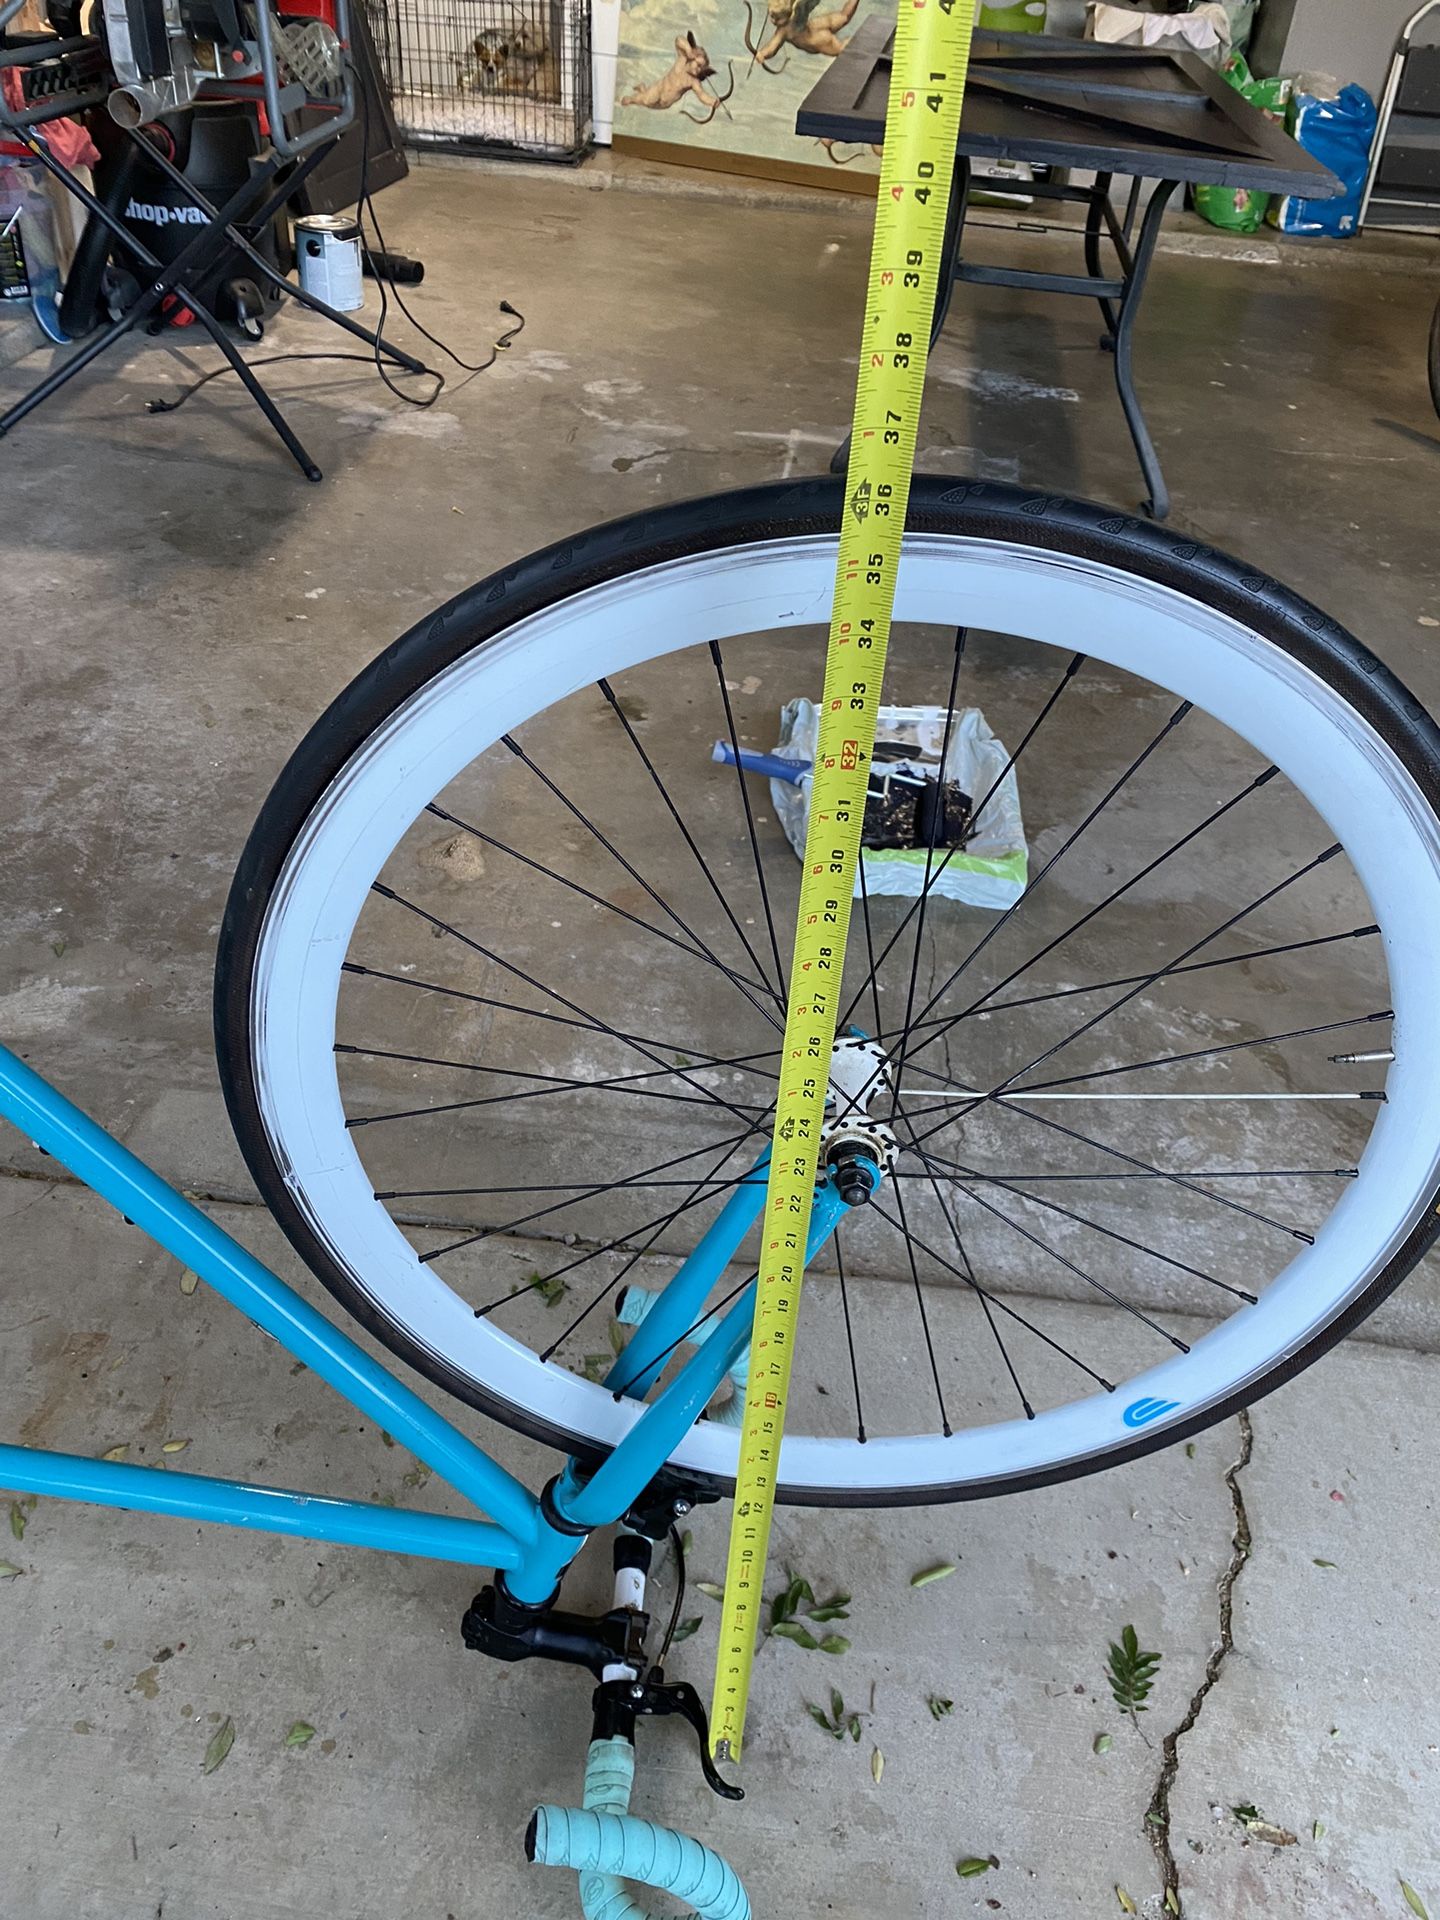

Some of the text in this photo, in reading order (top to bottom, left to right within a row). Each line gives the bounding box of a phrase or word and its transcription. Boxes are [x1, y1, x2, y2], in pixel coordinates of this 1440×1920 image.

[901, 92, 915, 107] 5
[927, 73, 946, 113] 41
[915, 162, 934, 205] 40
[891, 185, 904, 201] 4
[904, 250, 923, 288] 39
[881, 272, 894, 285] 3
[894, 333, 912, 368] 38
[872, 354, 884, 367] 2
[884, 411, 902, 444] 37
[856, 489, 869, 513] 3F
[875, 484, 892, 516] 36
[846, 560, 859, 580] 11
[867, 554, 883, 584] 35
[839, 623, 852, 645] 10
[858, 619, 875, 649] 34
[850, 682, 866, 710] 33
[832, 699, 842, 711] 9
[842, 742, 857, 767] 32
[825, 758, 835, 769] 8
[836, 800, 851, 821] 31
[819, 814, 829, 824] 7
[830, 850, 844, 873] 30
[813, 864, 823, 875] 6
[807, 914, 817, 924] 5
[824, 900, 838, 923] 29
[818, 947, 832, 969] 28
[803, 962, 812, 971] 4
[797, 1006, 807, 1015] 3
[813, 993, 826, 1014] 27
[792, 1049, 802, 1058] 2
[808, 1037, 821, 1057] 26
[803, 1078, 815, 1098] 25
[798, 1118, 811, 1138] 24
[779, 1162, 788, 1174] 11
[794, 1157, 806, 1176] 23
[774, 1197, 784, 1211] 10
[790, 1195, 801, 1213] 22
[785, 1233, 796, 1248] 21
[781, 1266, 792, 1283] 20
[778, 1299, 788, 1312] 19
[774, 1331, 784, 1344] 18
[756, 1371, 764, 1379] 5
[770, 1362, 780, 1375] 17
[765, 1393, 776, 1407] 16
[763, 1421, 773, 1433] 15
[760, 1449, 769, 1461] 14
[756, 1476, 766, 1488] 13
[754, 1502, 763, 1513] 12
[745, 1527, 756, 1539] 11
[742, 1550, 753, 1562] 10
